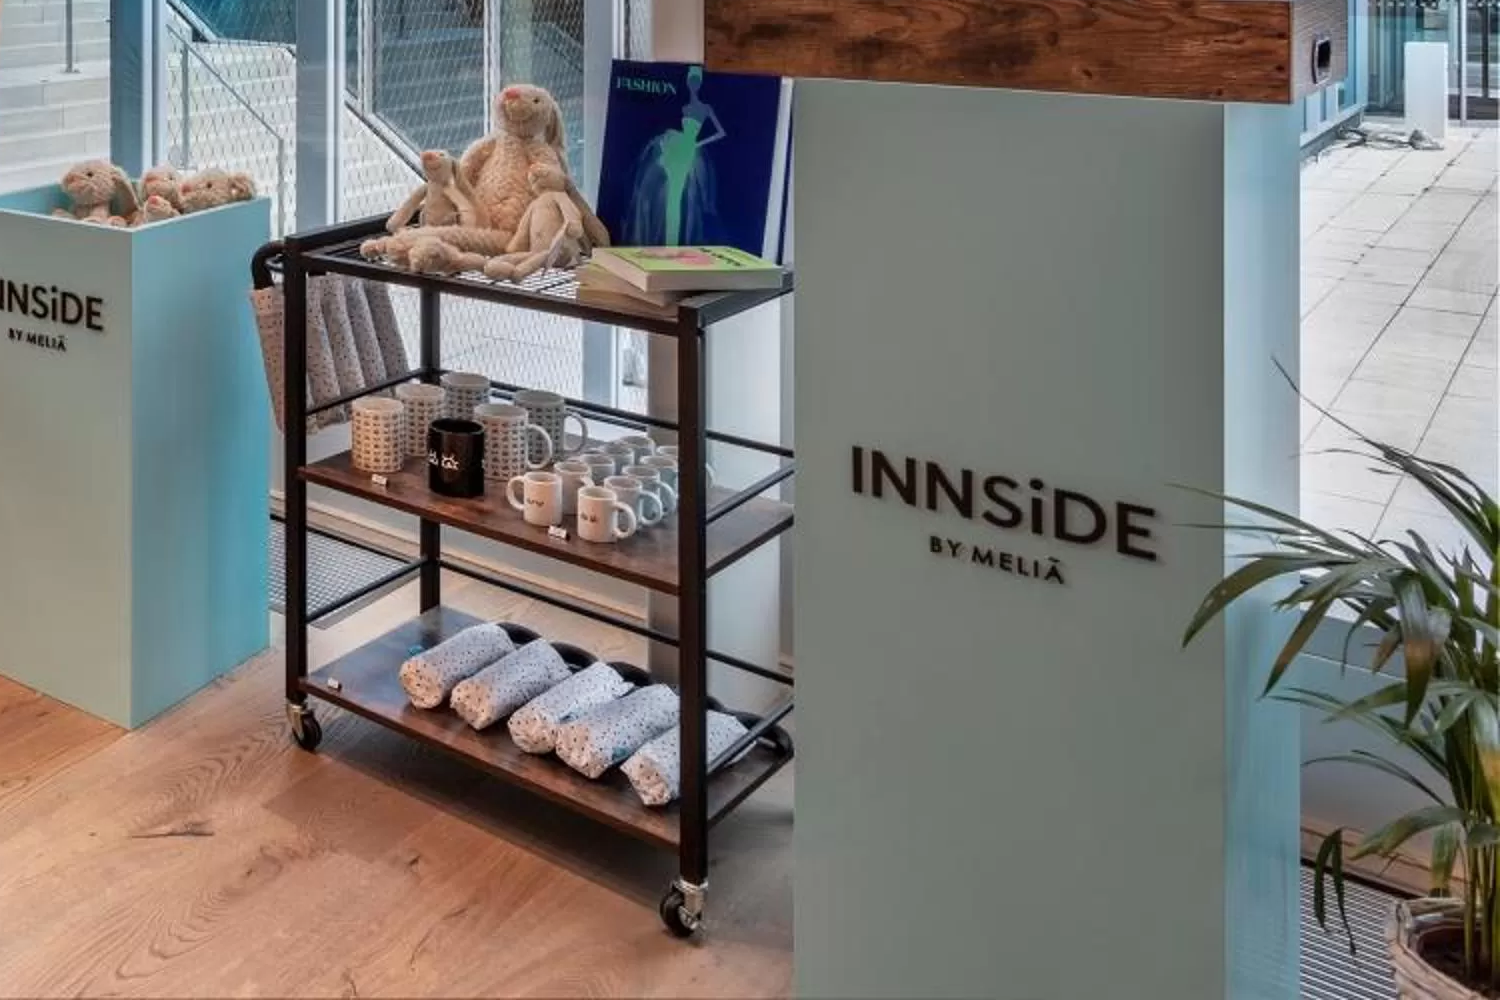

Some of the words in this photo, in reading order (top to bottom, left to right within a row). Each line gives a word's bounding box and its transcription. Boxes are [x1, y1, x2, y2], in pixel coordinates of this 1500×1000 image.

[616, 76, 677, 95] FASHION
[8, 327, 23, 341] BY
[852, 446, 1157, 561] INNSiDE
[929, 535, 961, 558] BY
